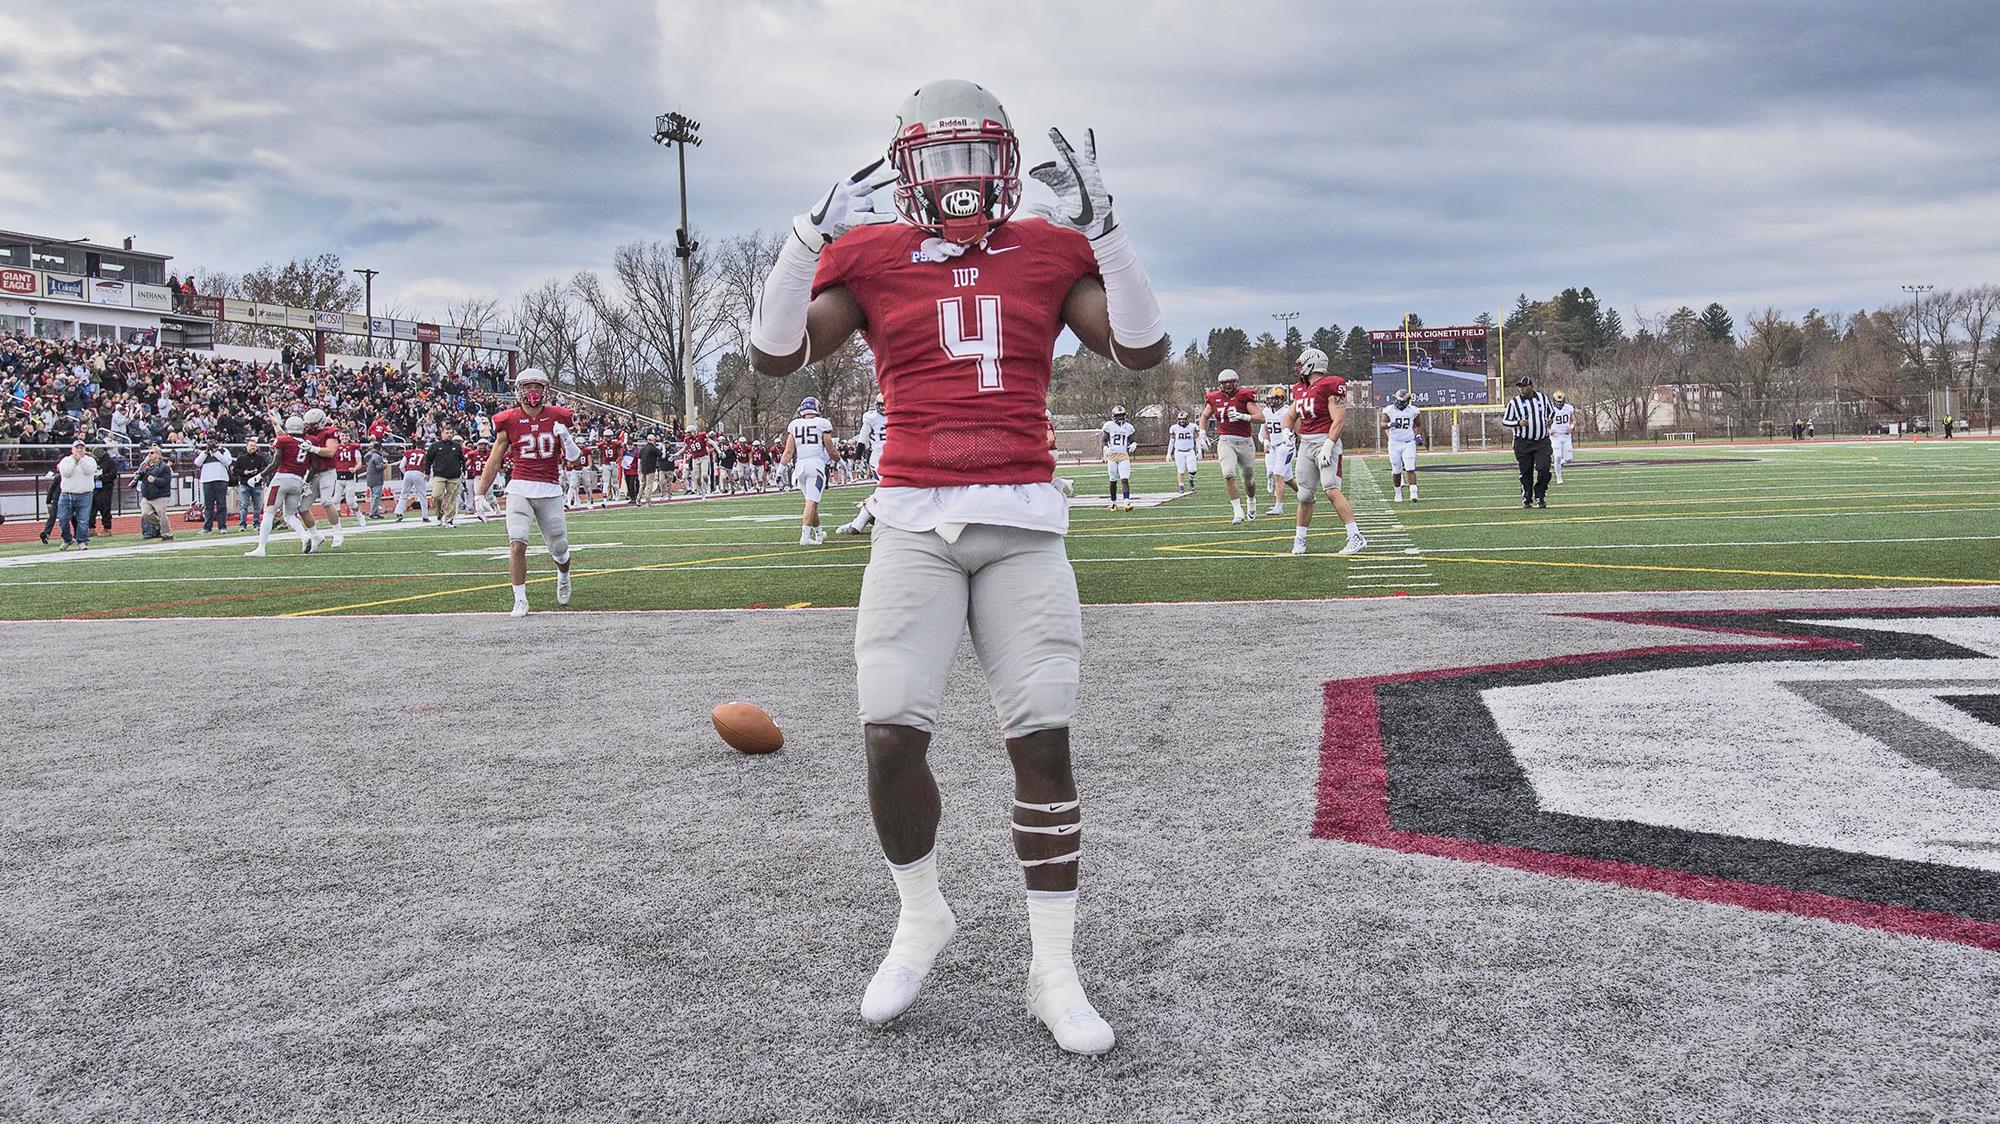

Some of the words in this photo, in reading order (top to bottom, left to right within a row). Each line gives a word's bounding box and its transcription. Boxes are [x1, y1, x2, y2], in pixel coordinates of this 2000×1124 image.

[939, 120, 967, 128] Riddell
[2, 272, 32, 282] GIANT
[952, 267, 979, 288] IUP
[3, 281, 32, 291] EAGLE
[138, 291, 167, 301] INDIANA
[29, 306, 37, 316] C
[1372, 332, 1385, 340] IUP
[1395, 331, 1422, 339] FRANK
[1424, 329, 1460, 338] CIGNETTI
[1462, 328, 1484, 336] FIELD
[936, 295, 1004, 392] 4
[795, 425, 819, 445] 45
[1112, 433, 1126, 446] 21
[518, 432, 556, 459] 20
[339, 451, 352, 461] 14
[408, 452, 424, 466] 27
